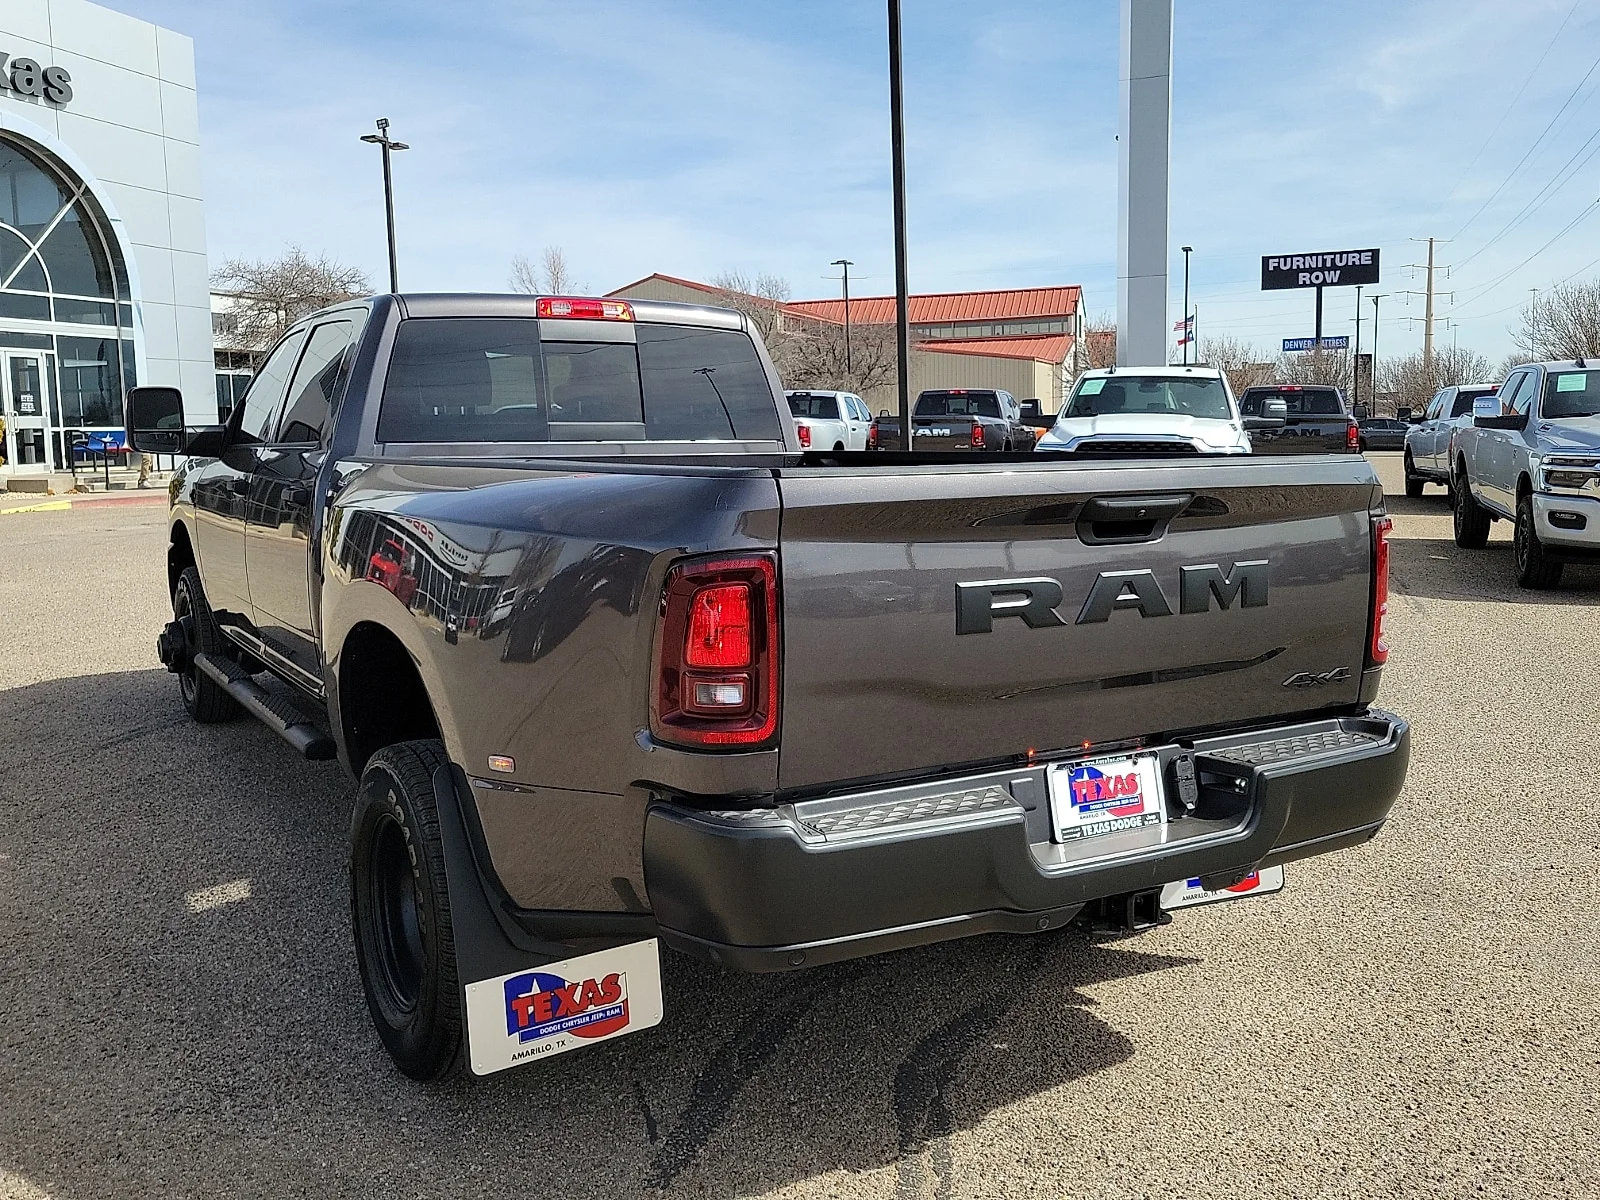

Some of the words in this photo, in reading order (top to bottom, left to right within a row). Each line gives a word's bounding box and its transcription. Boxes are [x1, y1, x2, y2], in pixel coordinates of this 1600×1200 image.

[1268, 252, 1372, 271] FURNITURE
[1298, 270, 1341, 285] ROW
[1284, 340, 1312, 349] DENVER
[1313, 338, 1347, 348] ATTRESS
[955, 559, 1269, 636] RAM
[1072, 772, 1138, 803] TEXAS
[1081, 821, 1110, 836] TEXAS
[1110, 817, 1142, 831] DODGE
[511, 973, 622, 1028] TEXAS
[540, 1025, 560, 1035] DODGE
[562, 1016, 590, 1028] CHRYSLER
[511, 1044, 554, 1061] AMARILLO,
[556, 1040, 566, 1048] TX
